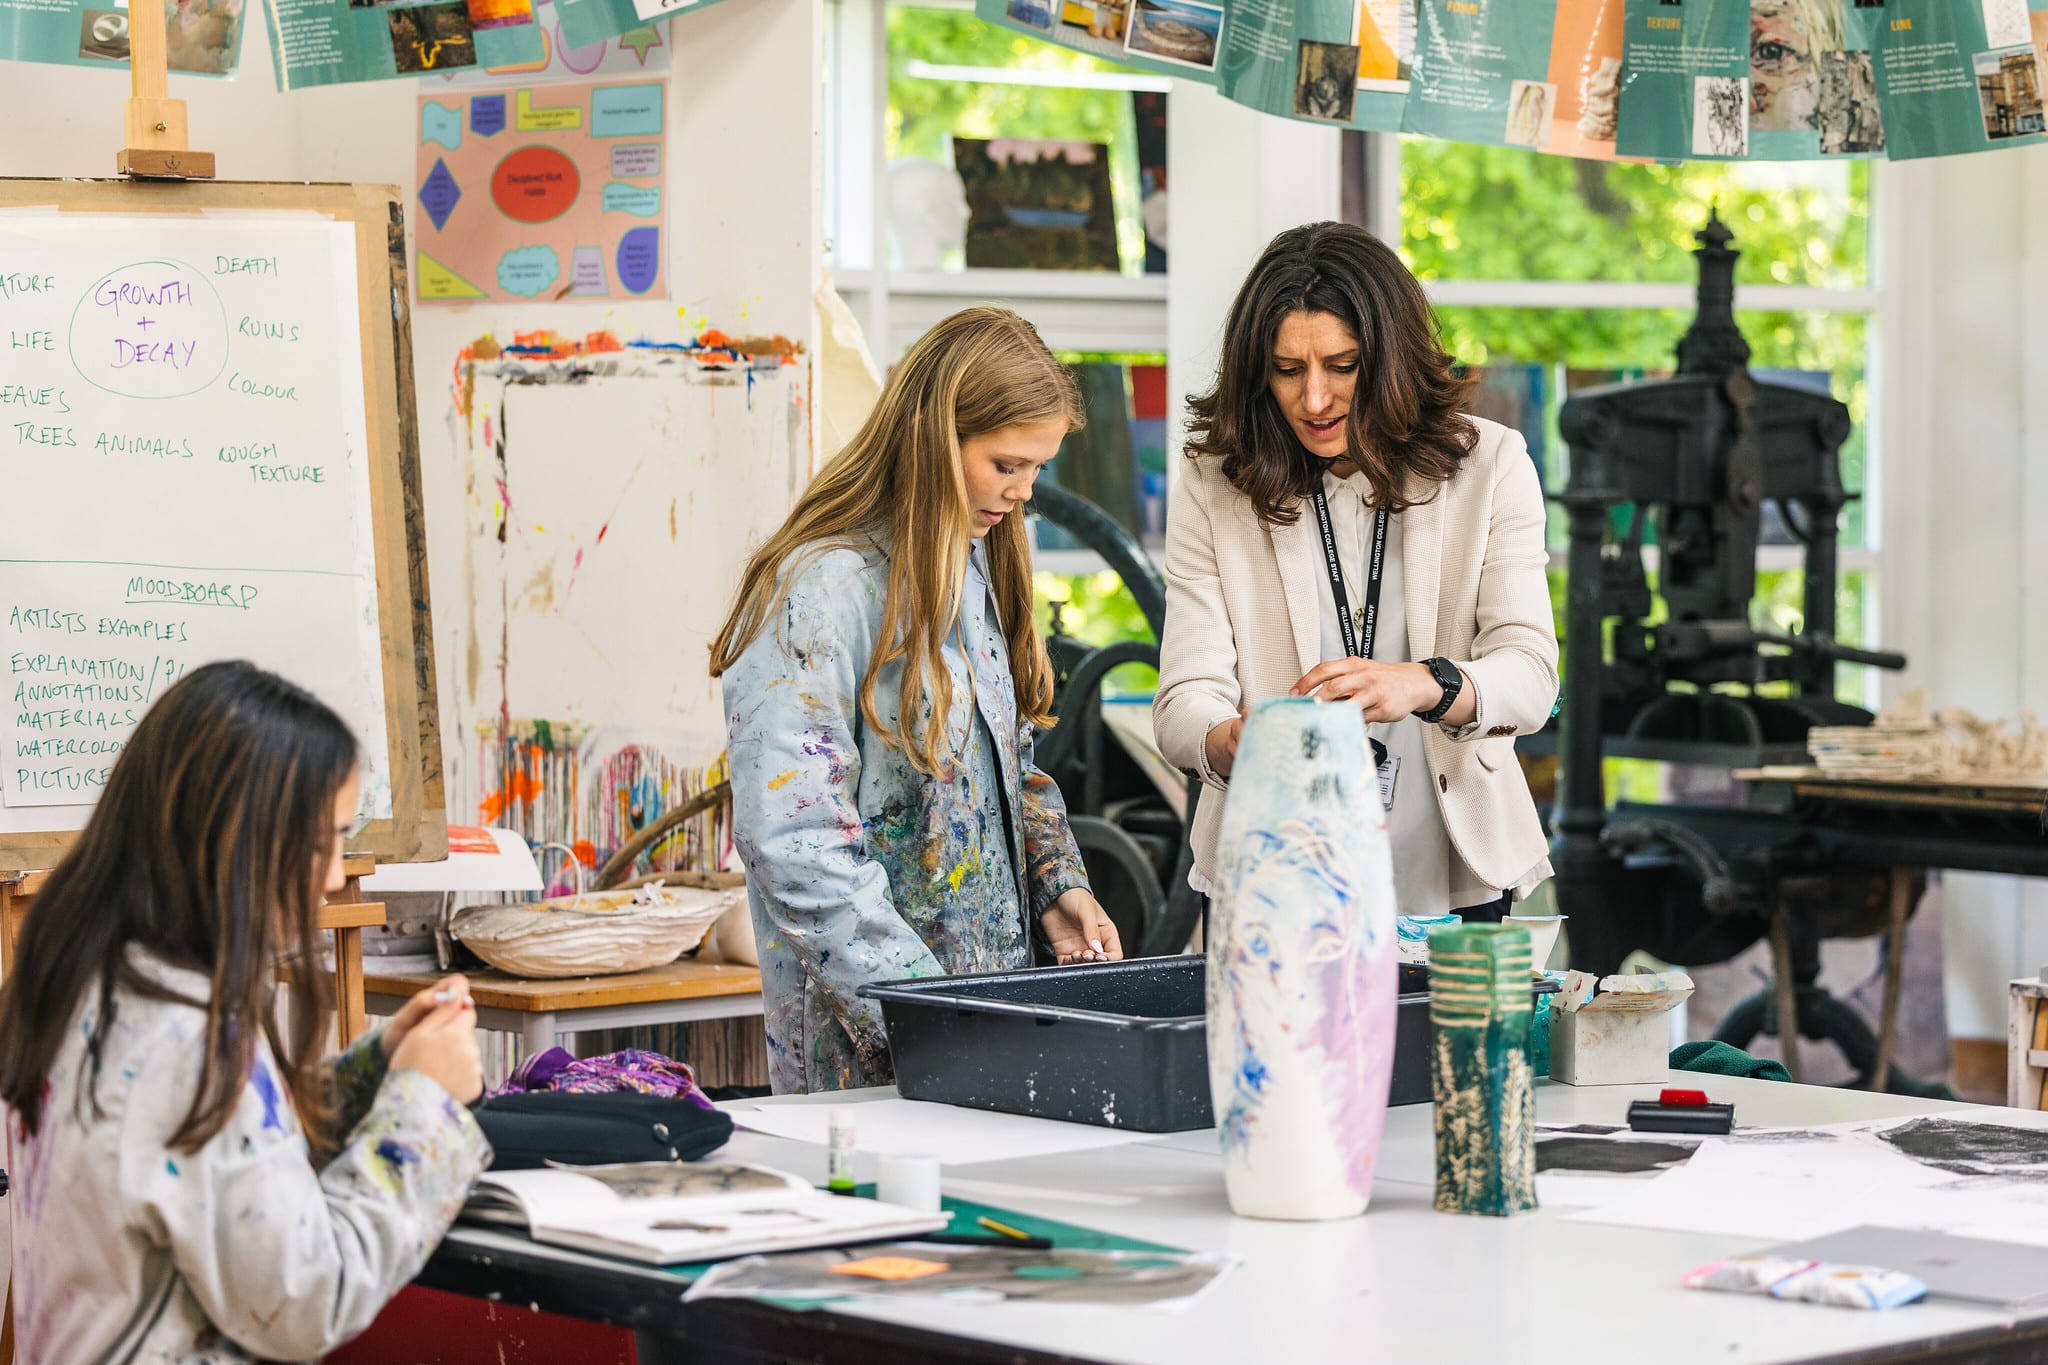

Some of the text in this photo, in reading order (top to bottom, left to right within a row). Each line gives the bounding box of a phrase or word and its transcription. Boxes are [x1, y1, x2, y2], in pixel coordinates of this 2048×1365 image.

[1446, 1, 1478, 16] FORM
[1647, 16, 1681, 30] TEXTURE
[1890, 18, 1912, 32] LINE
[214, 255, 278, 277] DEATH
[95, 279, 192, 317] GROWTH
[137, 316, 156, 331] +
[239, 315, 299, 342] RUINS
[11, 331, 55, 351] LIFE
[110, 338, 195, 369] DECAY
[0, 385, 71, 413] EAVES
[228, 372, 297, 401] COLOUR
[14, 421, 194, 459] TREES ANIMALS
[218, 443, 278, 463] ROUGH
[249, 464, 326, 484] TEXTURE
[1316, 493, 1340, 583] WELLINGTON COLLEGE STAFF
[1372, 540, 1382, 581] WELLINGTON
[126, 576, 258, 610] MOODBOARD
[10, 605, 188, 642] ARTISTS EXAMPLES
[1340, 605, 1352, 646] WELLINGTON
[1367, 604, 1375, 624] STAFF
[1363, 624, 1373, 654] COLLEGE
[16, 708, 138, 731] MATERIALS
